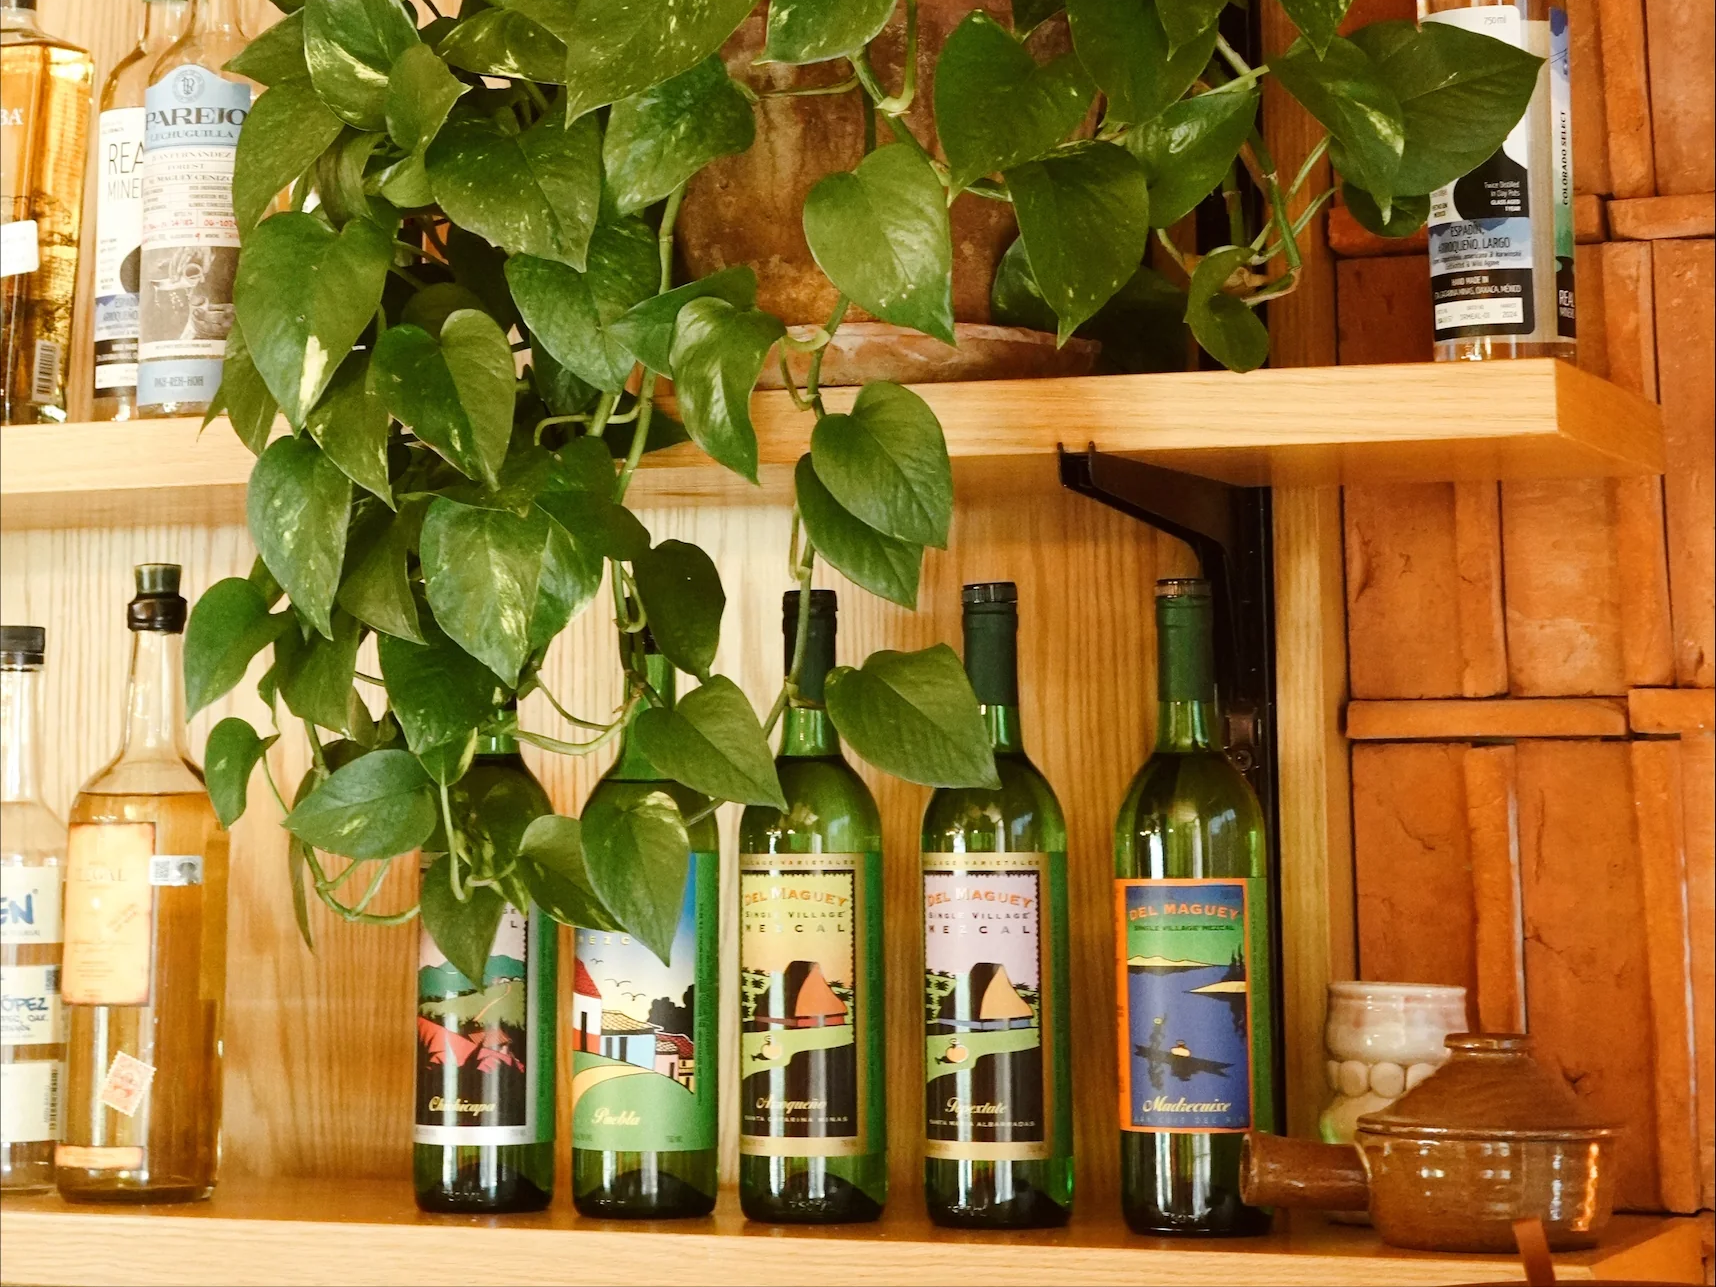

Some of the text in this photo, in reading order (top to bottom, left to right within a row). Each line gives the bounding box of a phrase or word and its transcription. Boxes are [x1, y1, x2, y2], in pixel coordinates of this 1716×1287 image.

[146, 107, 249, 130] PAREJO
[150, 130, 234, 142] LECHUGUILLA
[108, 142, 144, 175] REA
[1560, 110, 1569, 206] COLORADO SELECT
[1482, 237, 1511, 249] LARGO
[745, 886, 848, 906] DEL MAGUEY
[927, 887, 1033, 908] DEL MAGUEY
[1129, 902, 1239, 921] DEL MAGUEY
[756, 1094, 827, 1114] Aoqueño
[592, 1107, 641, 1126] Puebla
